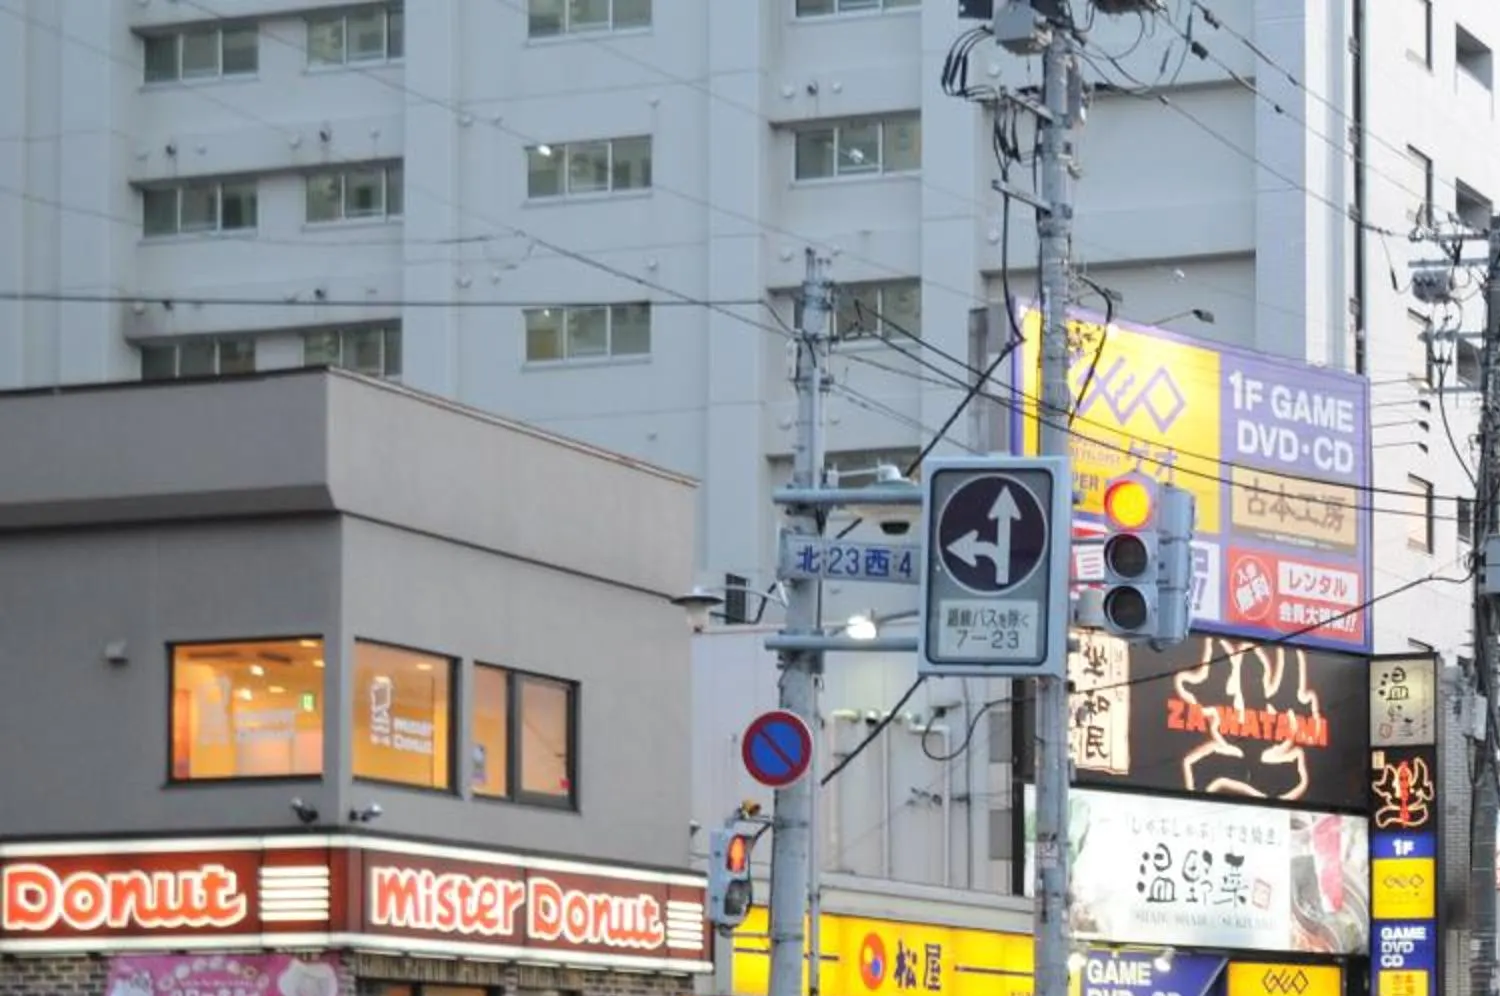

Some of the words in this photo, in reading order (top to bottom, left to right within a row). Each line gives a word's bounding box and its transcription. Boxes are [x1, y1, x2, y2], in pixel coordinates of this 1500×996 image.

[1229, 371, 1262, 411] 1F
[1270, 385, 1355, 433] GAME
[1244, 477, 1346, 533] 古本工房
[1288, 568, 1347, 597] レンタル
[1167, 698, 1207, 732] ZA
[1217, 704, 1328, 747] WATAMI
[1392, 839, 1415, 856] 1F
[3, 863, 247, 931] Donut
[371, 866, 526, 936] Mister
[527, 876, 665, 950] Donut
[1380, 926, 1427, 941] GAME
[1381, 941, 1414, 953] DVD
[893, 938, 942, 992] 松屋
[1086, 959, 1151, 986] GAME
[1380, 954, 1404, 968] CD
